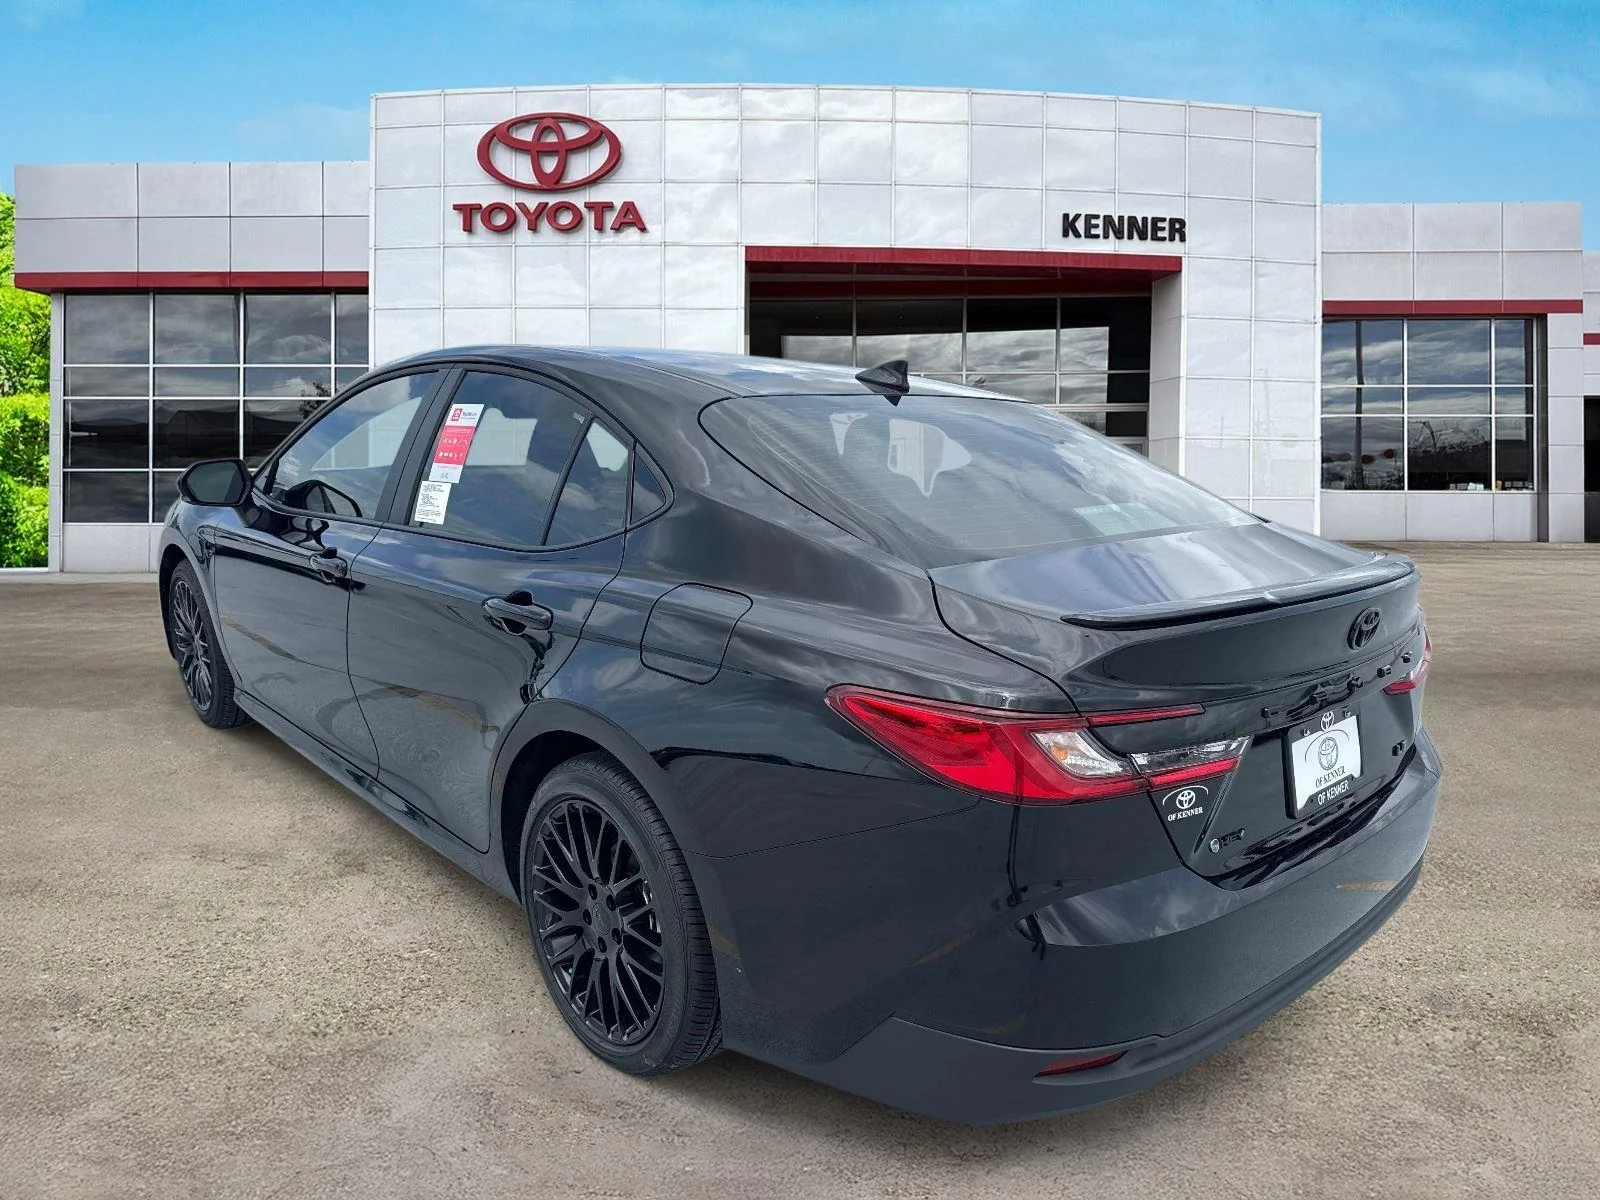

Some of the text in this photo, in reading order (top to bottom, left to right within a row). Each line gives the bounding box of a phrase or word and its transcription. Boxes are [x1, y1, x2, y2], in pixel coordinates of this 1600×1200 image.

[452, 201, 647, 233] TOYOTA
[1062, 213, 1187, 242] KENNER
[1315, 765, 1346, 788] OF KENNER
[1317, 780, 1349, 805] OF KENNER
[1167, 807, 1203, 822] OF KENNER
